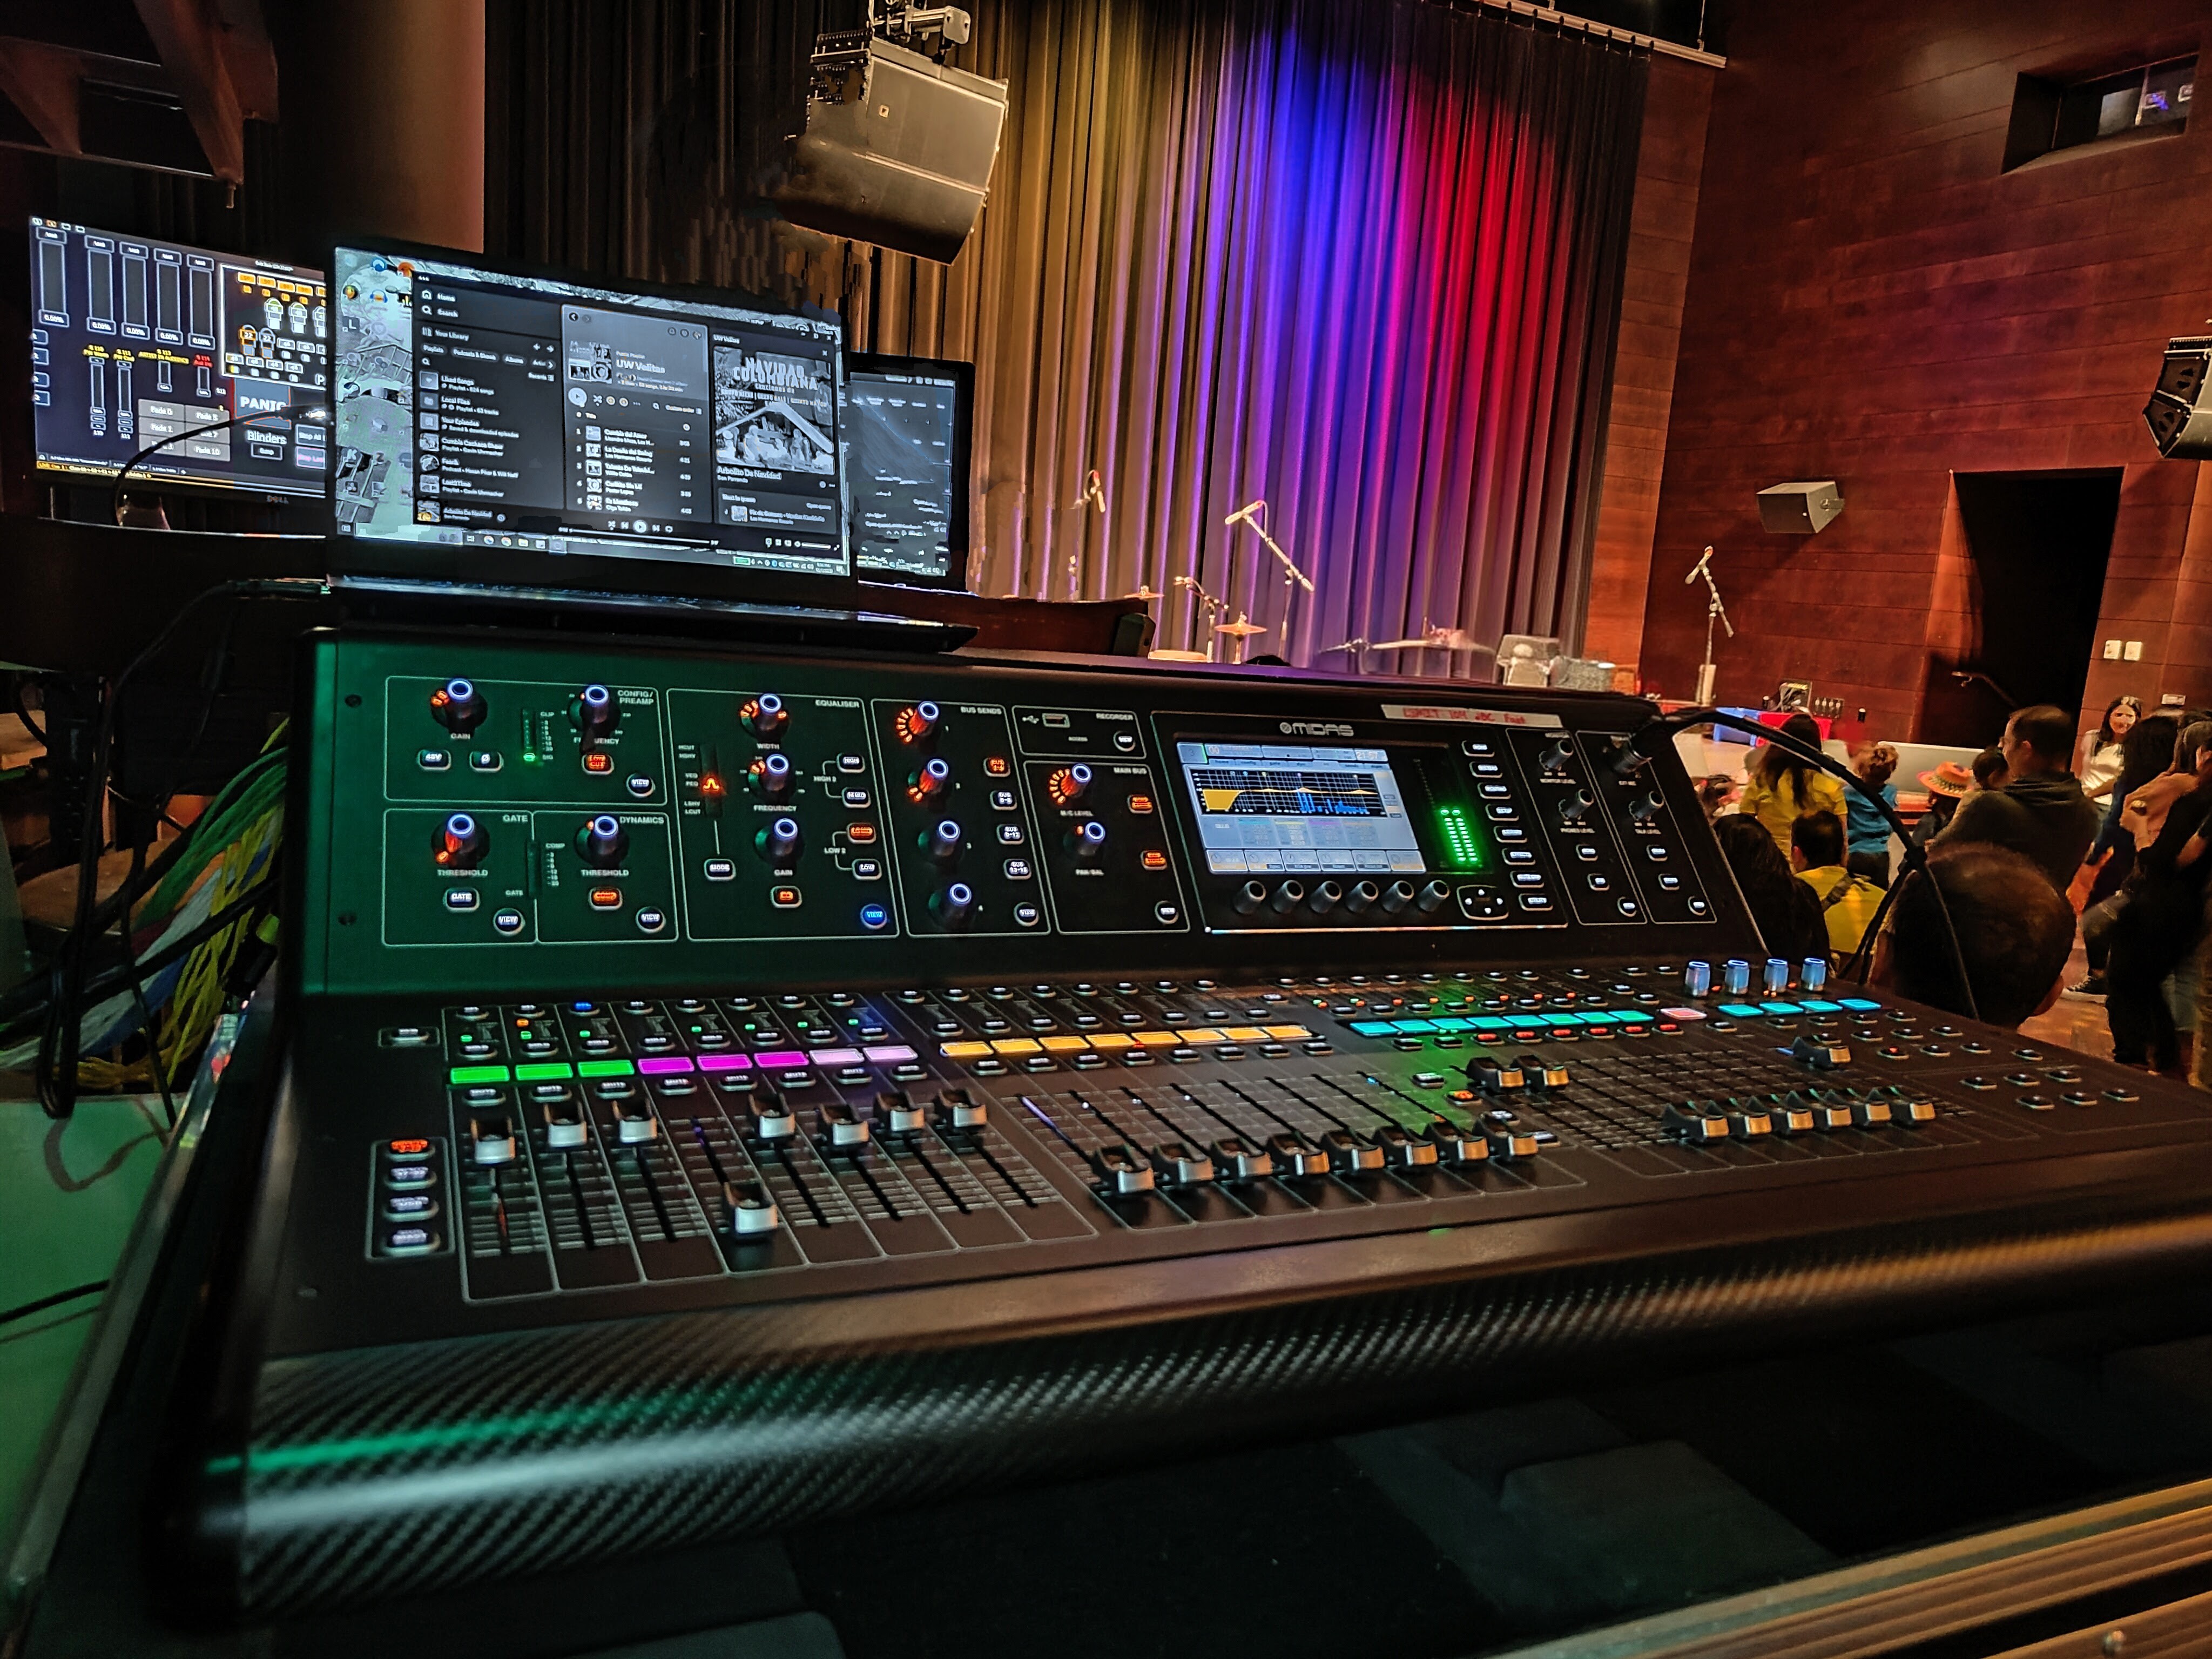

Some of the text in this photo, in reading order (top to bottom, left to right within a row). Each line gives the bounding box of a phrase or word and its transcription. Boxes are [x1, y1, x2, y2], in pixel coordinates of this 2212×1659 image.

[448, 332, 469, 341] Library
[616, 359, 634, 369] UW
[746, 356, 804, 380] NAVIDAD
[733, 367, 818, 390] COLOMBIANA
[247, 430, 287, 445] Blinders
[717, 466, 782, 480] Arbolito De Navidad
[815, 700, 860, 708] EQUALISER
[1293, 723, 1354, 737] MIDAS
[632, 779, 650, 787] VIEW
[451, 893, 473, 901] GATE
[498, 916, 518, 925] VIEW
[641, 913, 660, 922] VIEW
